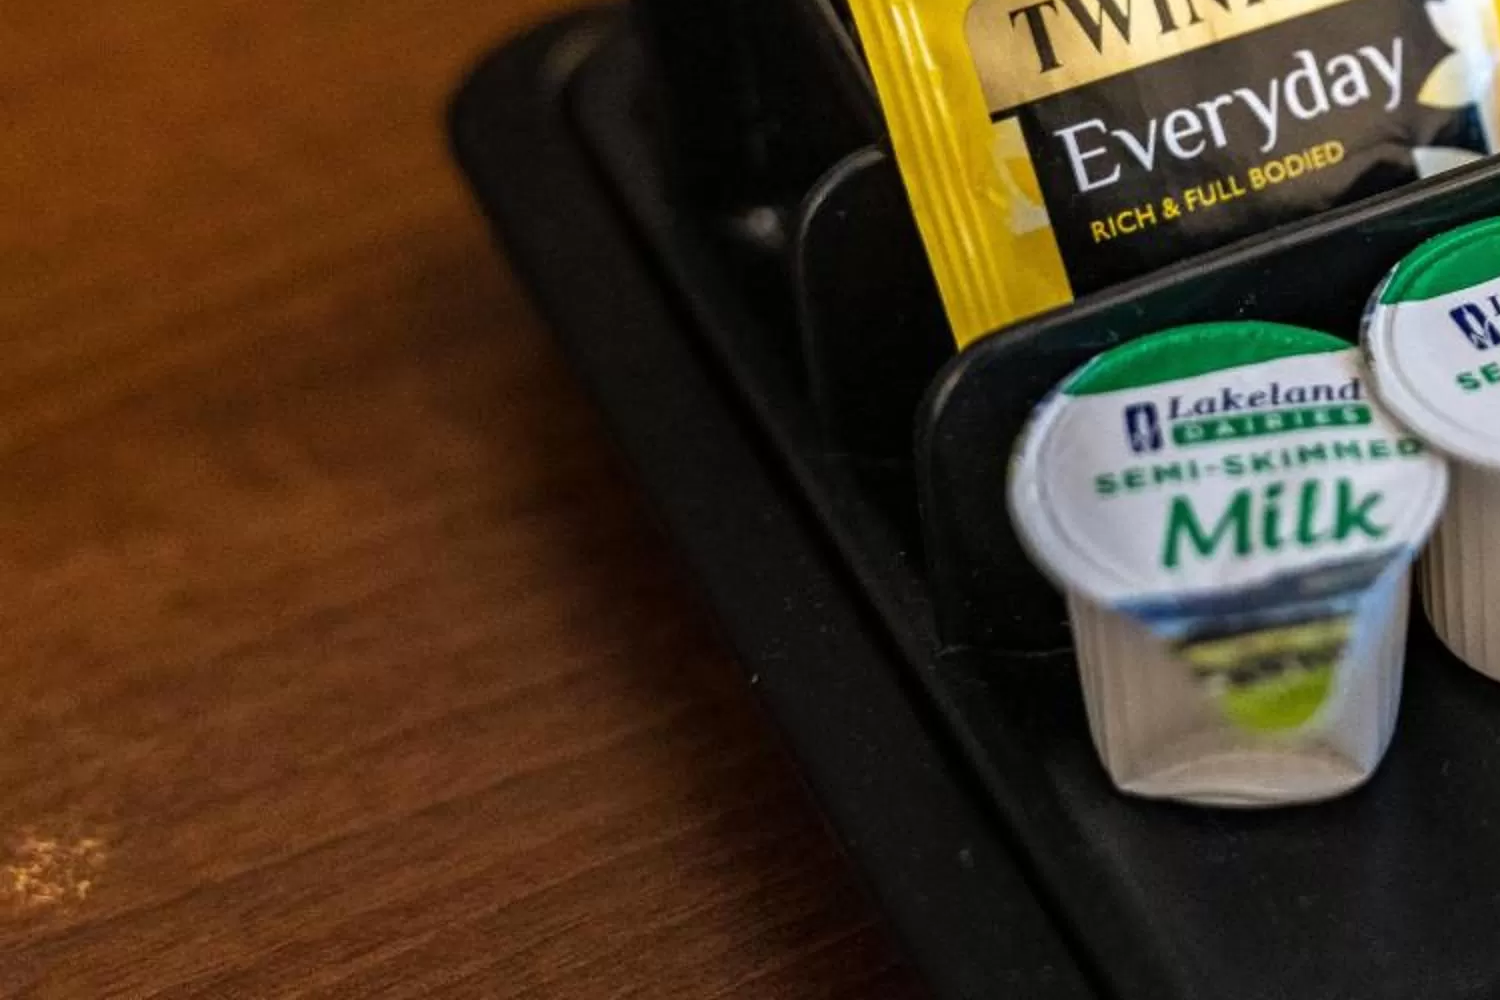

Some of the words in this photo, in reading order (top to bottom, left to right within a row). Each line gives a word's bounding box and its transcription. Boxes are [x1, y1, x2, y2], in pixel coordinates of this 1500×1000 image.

[1052, 37, 1404, 194] Everyday
[1090, 203, 1158, 244] RICH
[1162, 196, 1182, 220] &
[1183, 175, 1247, 215] FULL
[1248, 139, 1346, 191] BODIED
[1168, 377, 1362, 420] Lakeland
[1182, 404, 1363, 441] DAIRIES
[1094, 437, 1424, 495] SEMI-SKIMMED
[1163, 477, 1391, 569] Milk
